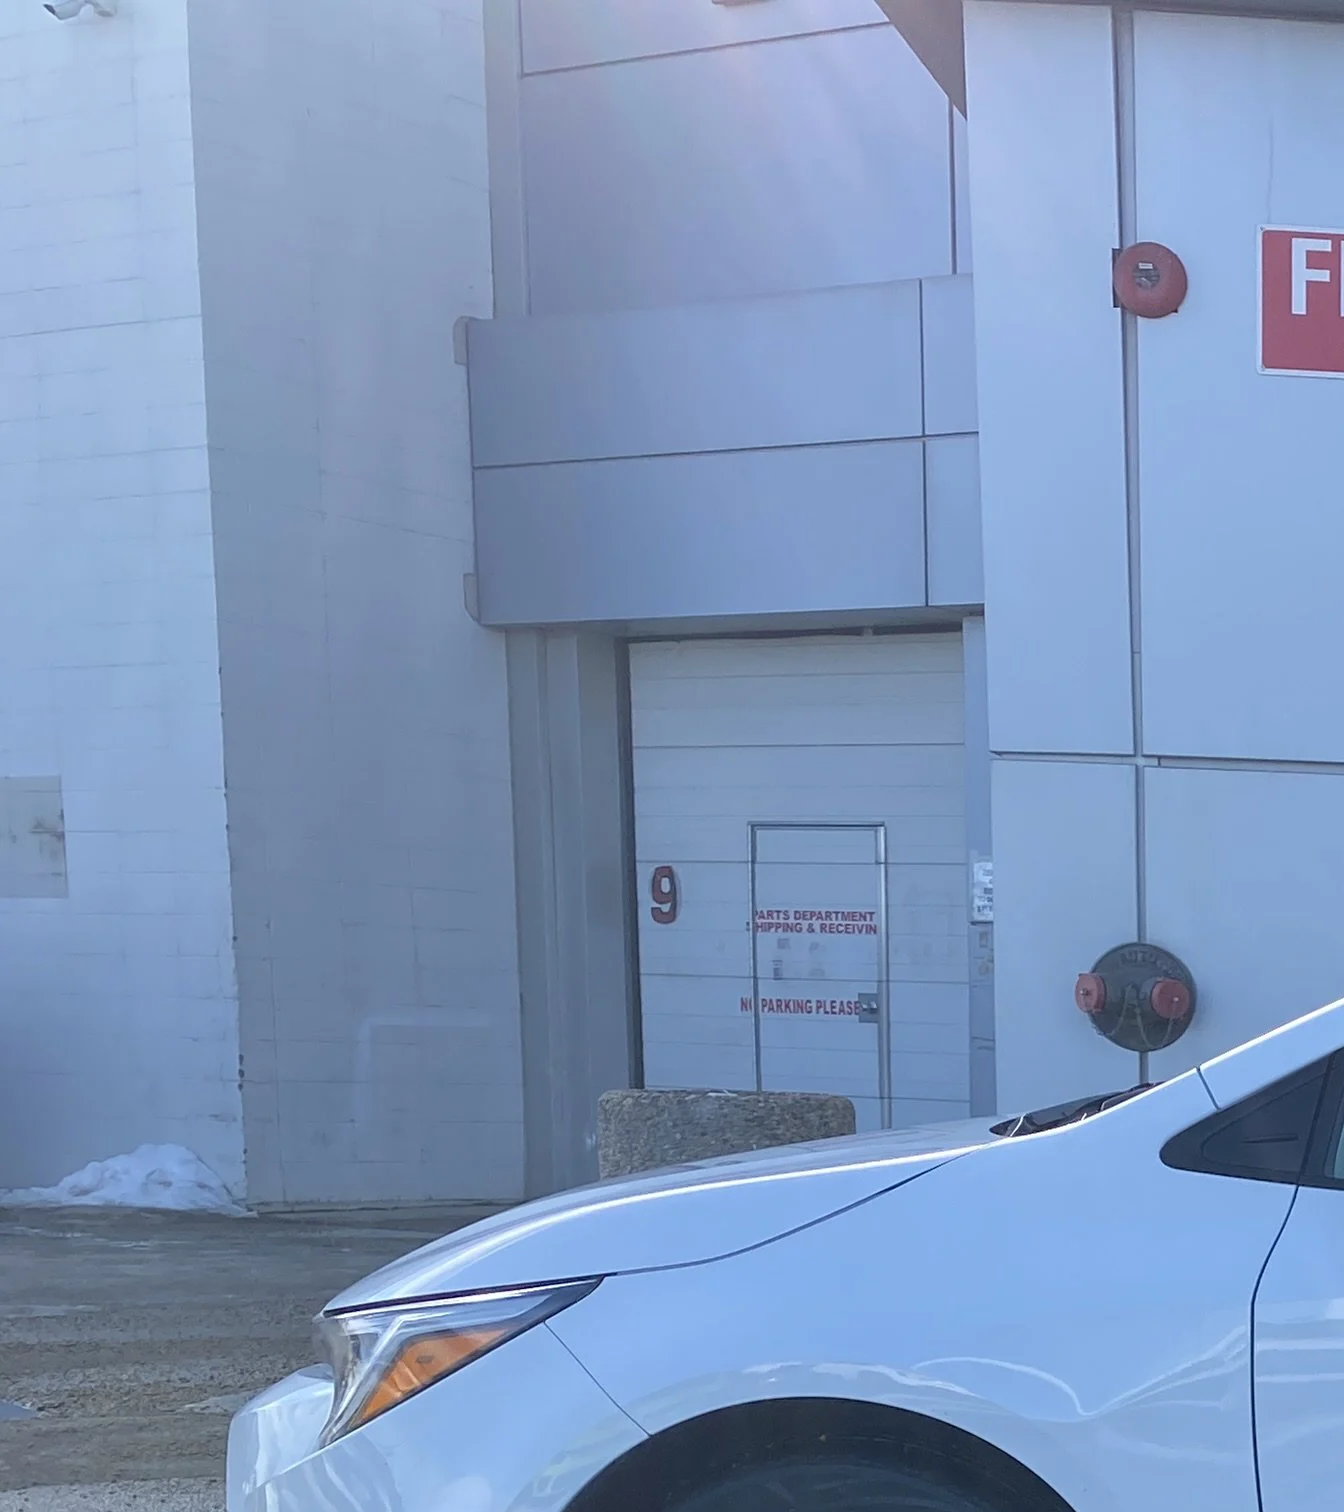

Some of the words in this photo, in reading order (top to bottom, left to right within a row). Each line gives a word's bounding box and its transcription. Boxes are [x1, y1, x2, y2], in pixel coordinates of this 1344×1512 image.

[651, 865, 677, 925] 9
[793, 910, 876, 922] DEPARTMENT
[806, 922, 816, 934] &
[761, 998, 813, 1014] PARKING
